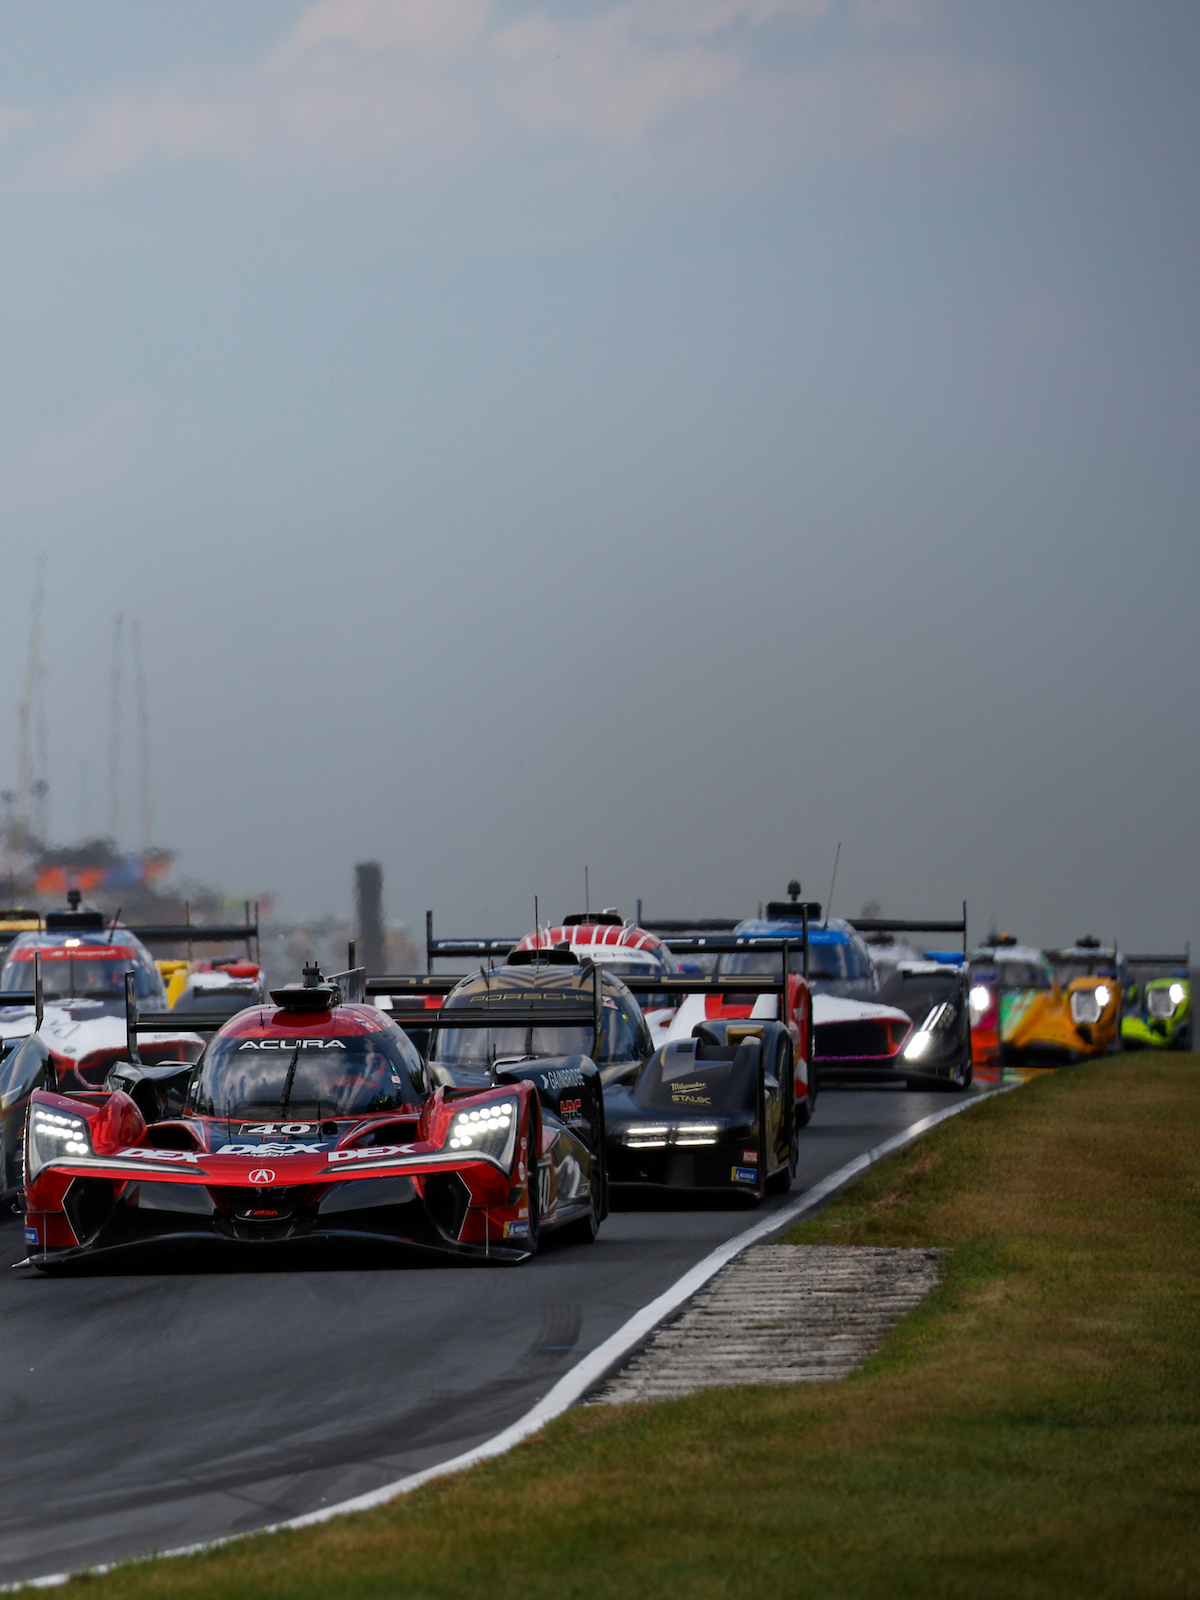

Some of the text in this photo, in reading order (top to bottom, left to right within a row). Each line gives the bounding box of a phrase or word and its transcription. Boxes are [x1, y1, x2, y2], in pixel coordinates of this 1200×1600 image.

[469, 992, 595, 1003] PORSCHE
[238, 1039, 347, 1051] ACURA
[671, 1094, 712, 1105] STALOC
[247, 1124, 311, 1135] 40
[215, 1142, 329, 1155] DEX
[328, 1143, 416, 1163] DEX
[116, 1147, 213, 1163] DEX
